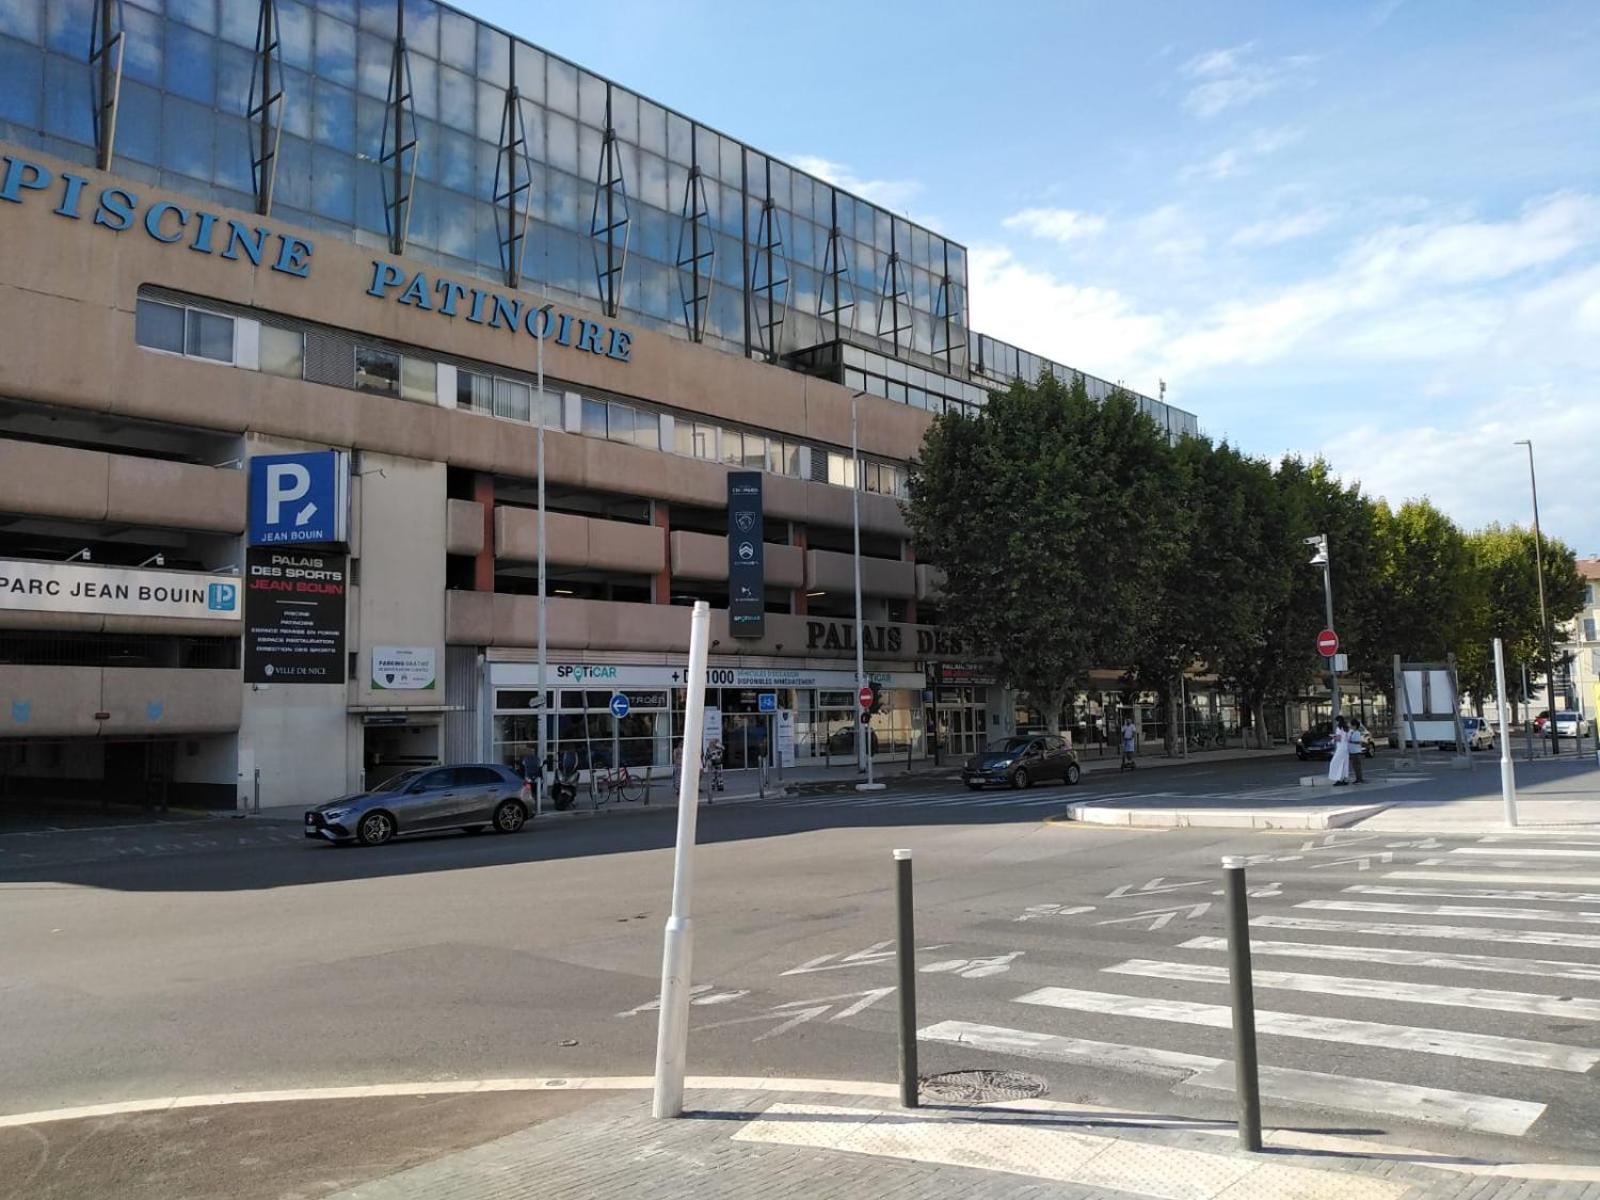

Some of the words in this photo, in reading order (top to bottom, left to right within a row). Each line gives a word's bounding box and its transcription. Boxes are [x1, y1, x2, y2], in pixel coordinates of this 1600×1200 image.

[0, 156, 315, 279] PISCINE
[366, 259, 634, 362] PATINOIRE
[266, 463, 310, 525] P
[261, 531, 288, 543] JEAN
[291, 529, 323, 542] BOUIN
[272, 555, 324, 568] PALAIS
[251, 565, 282, 576] DES
[286, 566, 343, 581] SPORTS
[70, 582, 129, 598] JEAN
[138, 586, 205, 603] BOUIN
[250, 579, 293, 591] JEAN
[296, 581, 344, 594] BOUIN
[806, 621, 902, 652] PALAIS
[916, 629, 963, 655] DES
[274, 666, 296, 675] VILLE
[296, 666, 308, 675] DE
[308, 667, 327, 676] NICE
[706, 670, 734, 684] 1000
